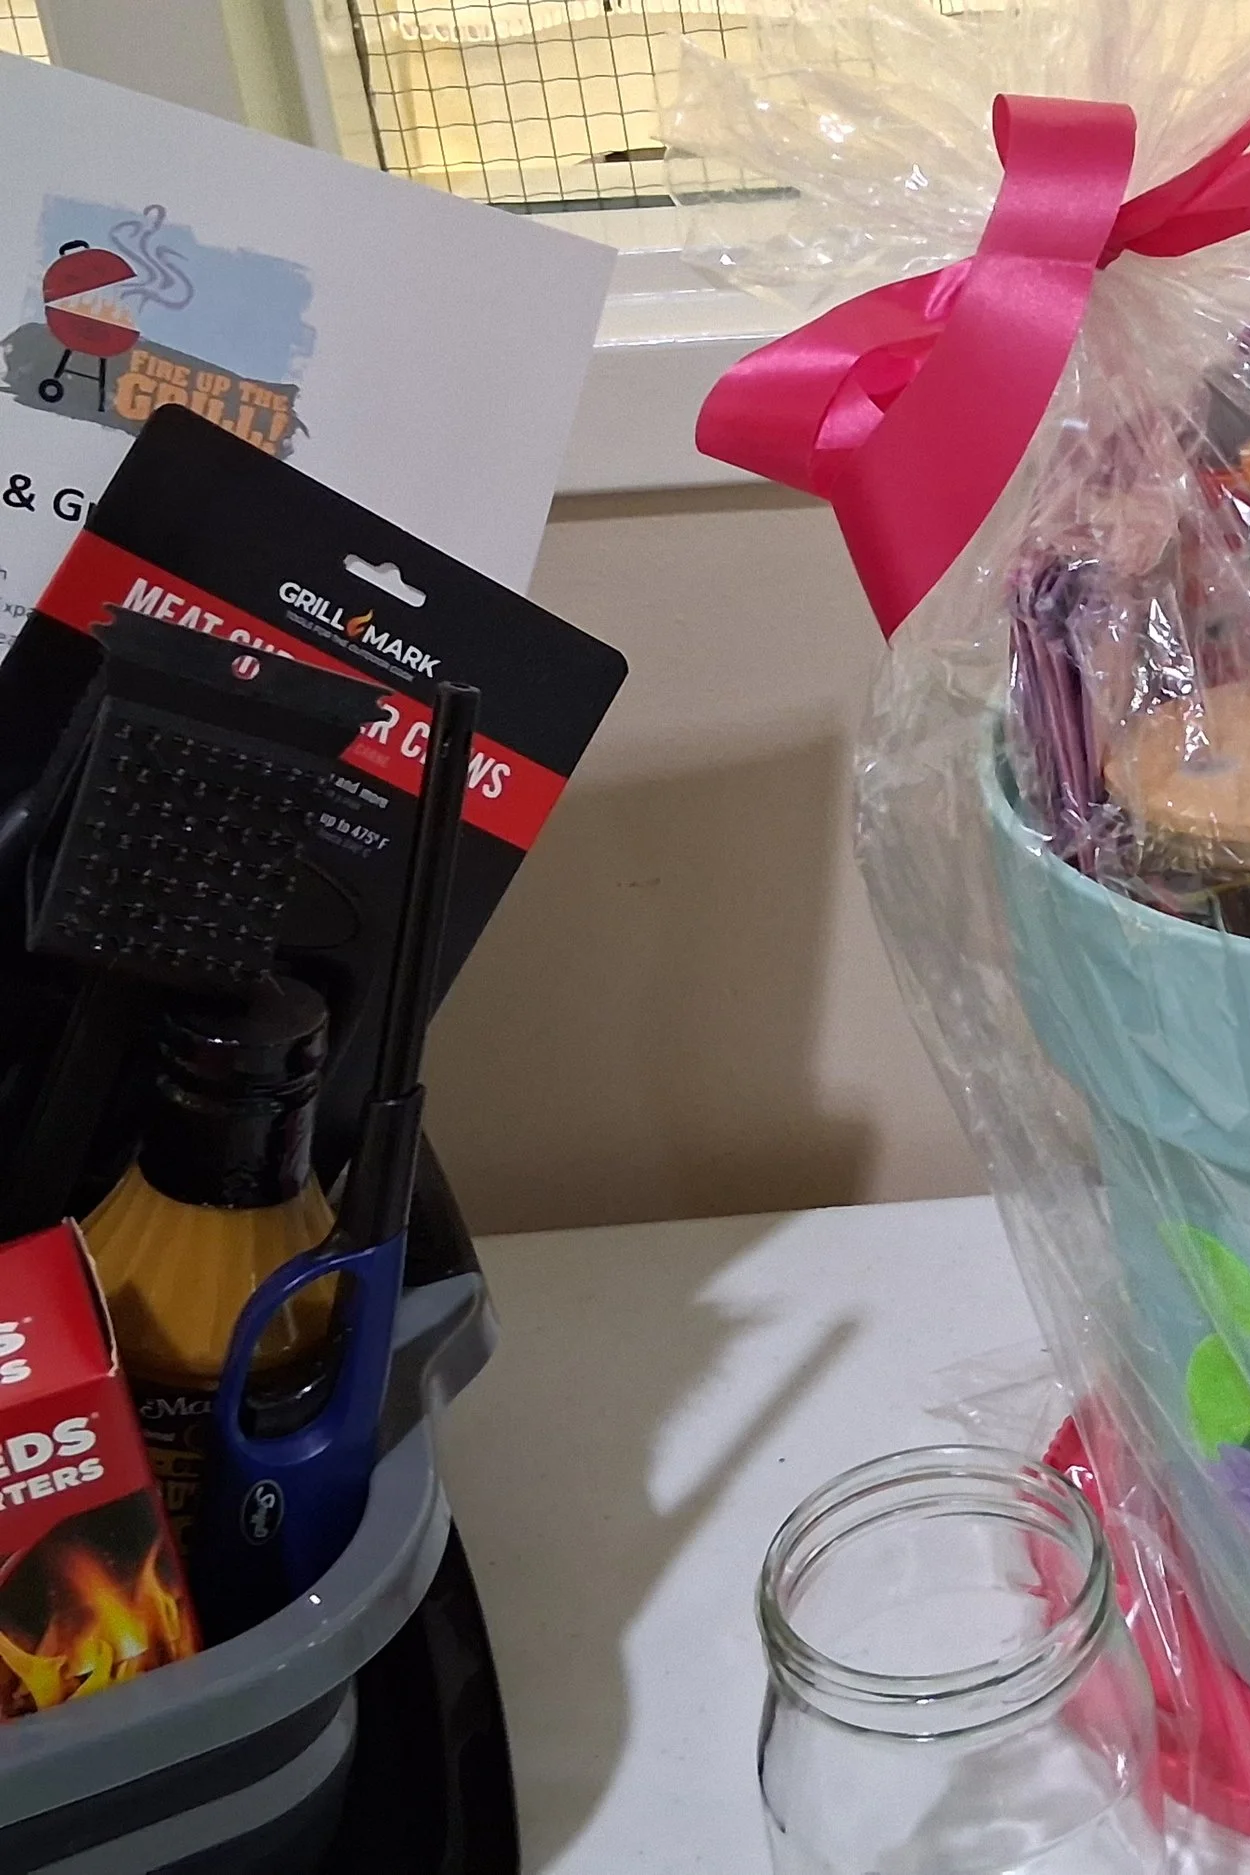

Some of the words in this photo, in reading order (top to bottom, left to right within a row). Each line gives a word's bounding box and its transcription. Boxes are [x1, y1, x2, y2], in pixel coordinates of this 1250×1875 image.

[196, 371, 231, 397] UP
[2, 474, 36, 512] &
[279, 581, 345, 631] GRILL
[361, 624, 441, 678] MARK
